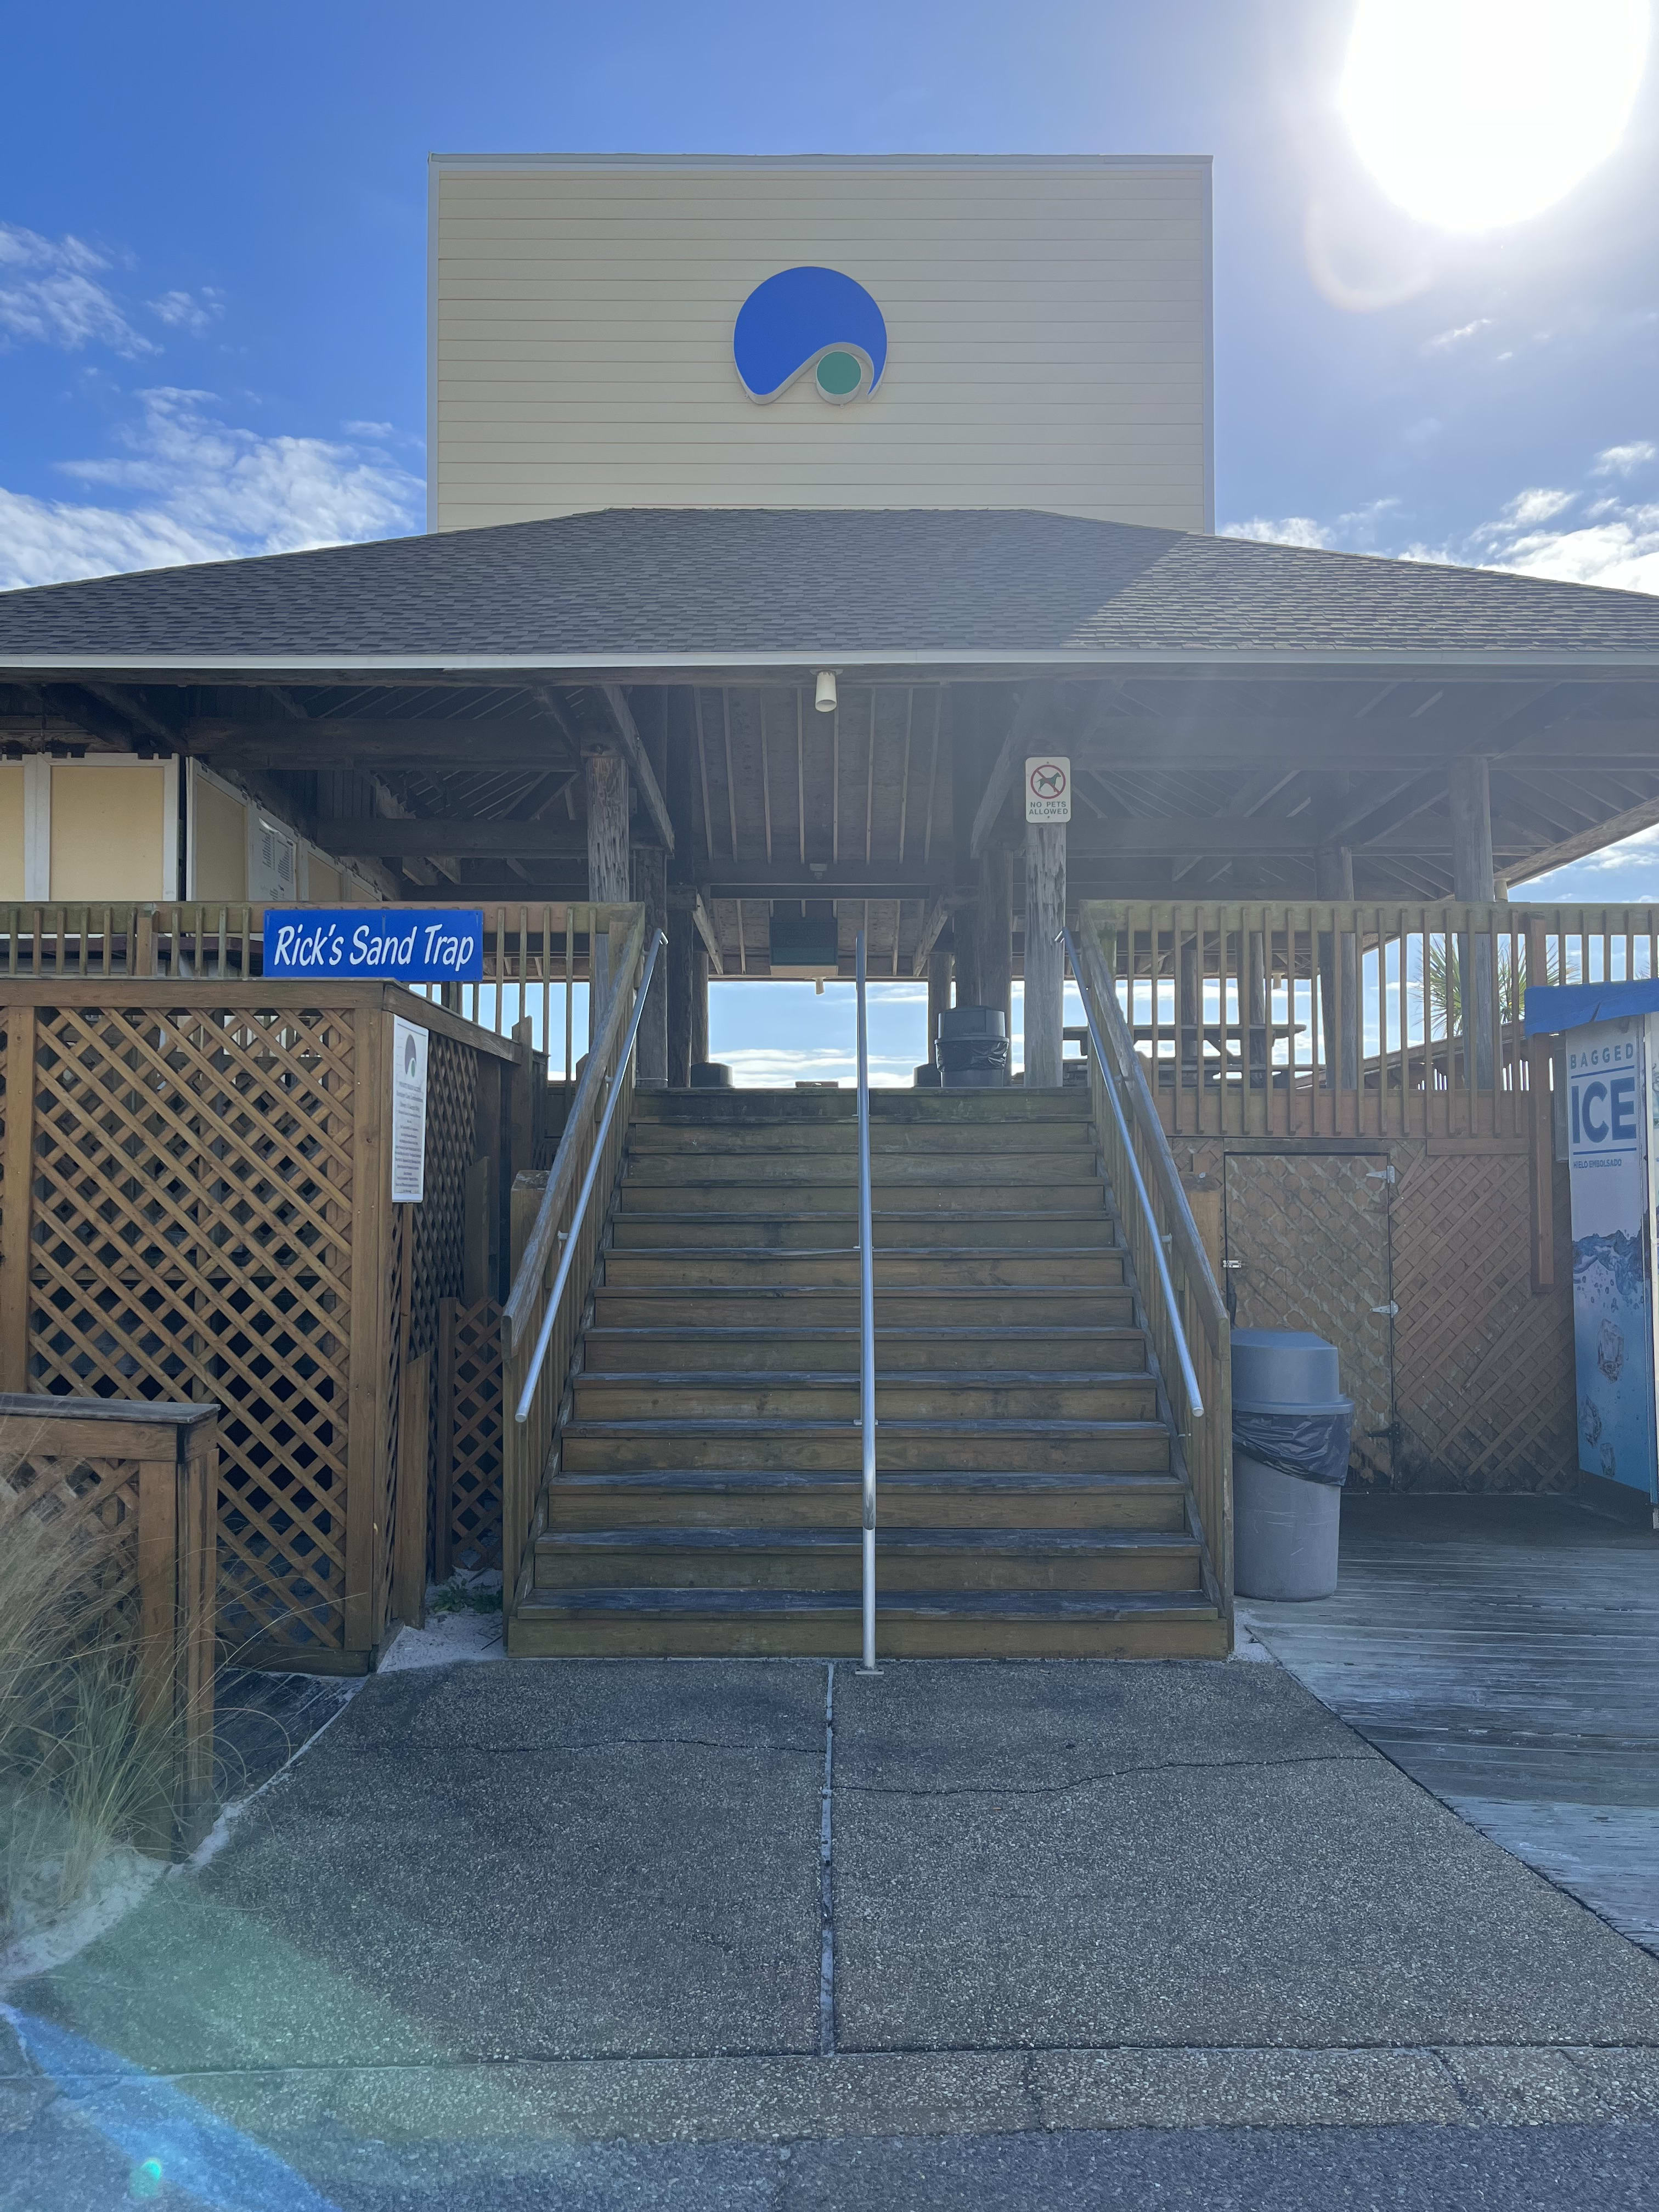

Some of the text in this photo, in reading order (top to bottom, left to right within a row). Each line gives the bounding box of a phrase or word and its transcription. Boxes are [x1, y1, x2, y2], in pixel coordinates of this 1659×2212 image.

[273, 923, 474, 972] Rick's Sand Trap
[1570, 1043, 1633, 1069] BAGGED
[1571, 1077, 1637, 1143] ICE
[1589, 1159, 1622, 1168] EMBOLSADO
